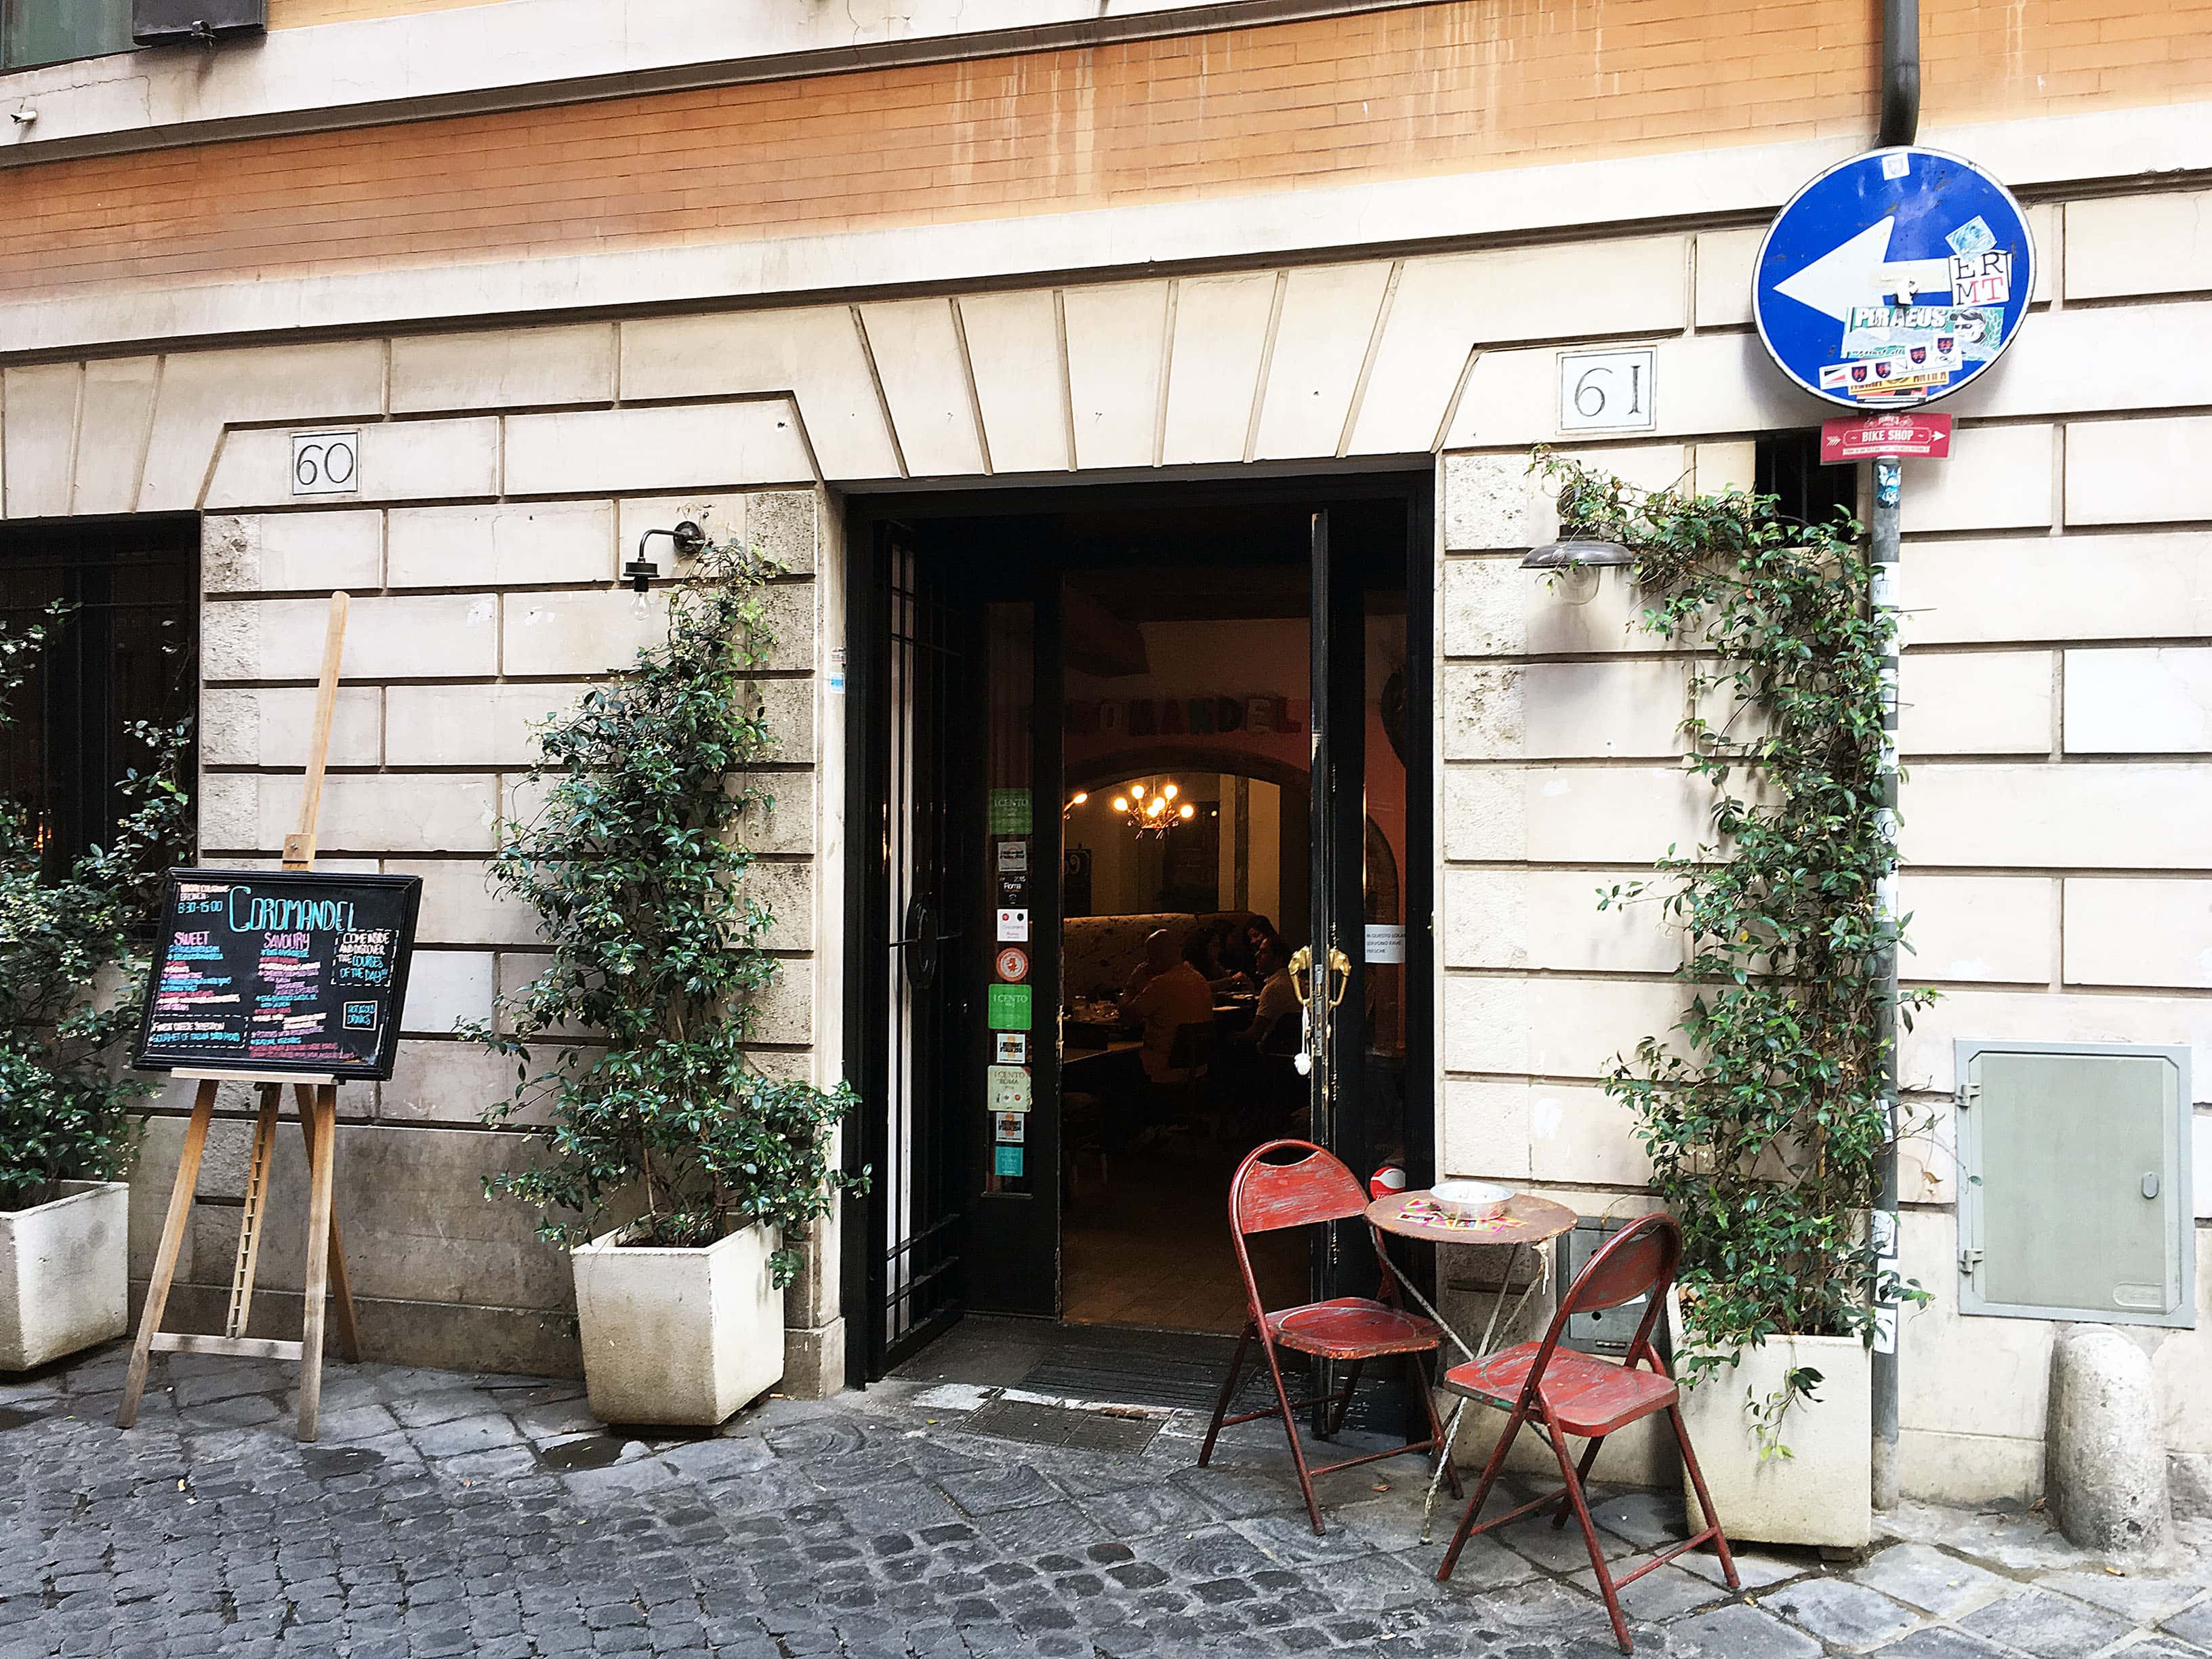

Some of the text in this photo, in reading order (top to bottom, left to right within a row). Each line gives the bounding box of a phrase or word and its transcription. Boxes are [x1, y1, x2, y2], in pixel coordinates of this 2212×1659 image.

[1574, 365, 1643, 417] 61
[1862, 429, 1914, 443] BIKE SHOP
[296, 443, 354, 485] 60
[173, 931, 210, 945] SWEET
[263, 932, 310, 950] SAVOURY
[343, 933, 367, 944] COME
[340, 968, 351, 978] OF
[350, 968, 365, 978] THE
[997, 994, 1028, 1002] CENTO
